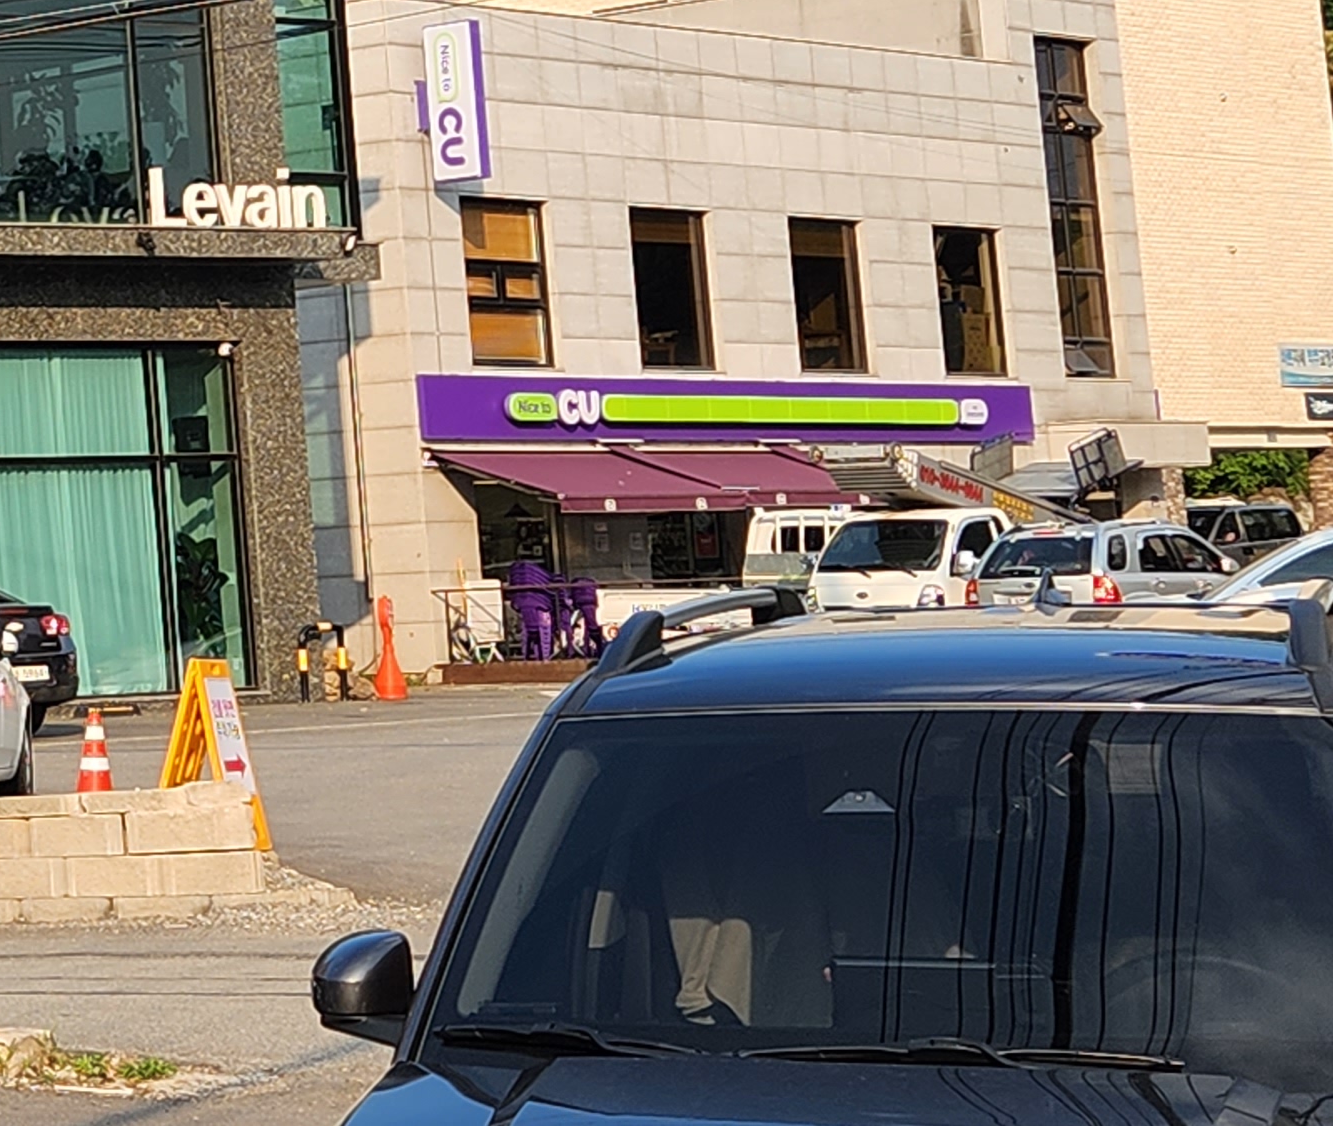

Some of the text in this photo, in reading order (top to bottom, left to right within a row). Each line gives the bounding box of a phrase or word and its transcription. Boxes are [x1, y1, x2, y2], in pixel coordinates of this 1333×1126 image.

[437, 44, 466, 167] Nice to CU
[148, 167, 327, 228] Levain
[557, 389, 600, 425] CU
